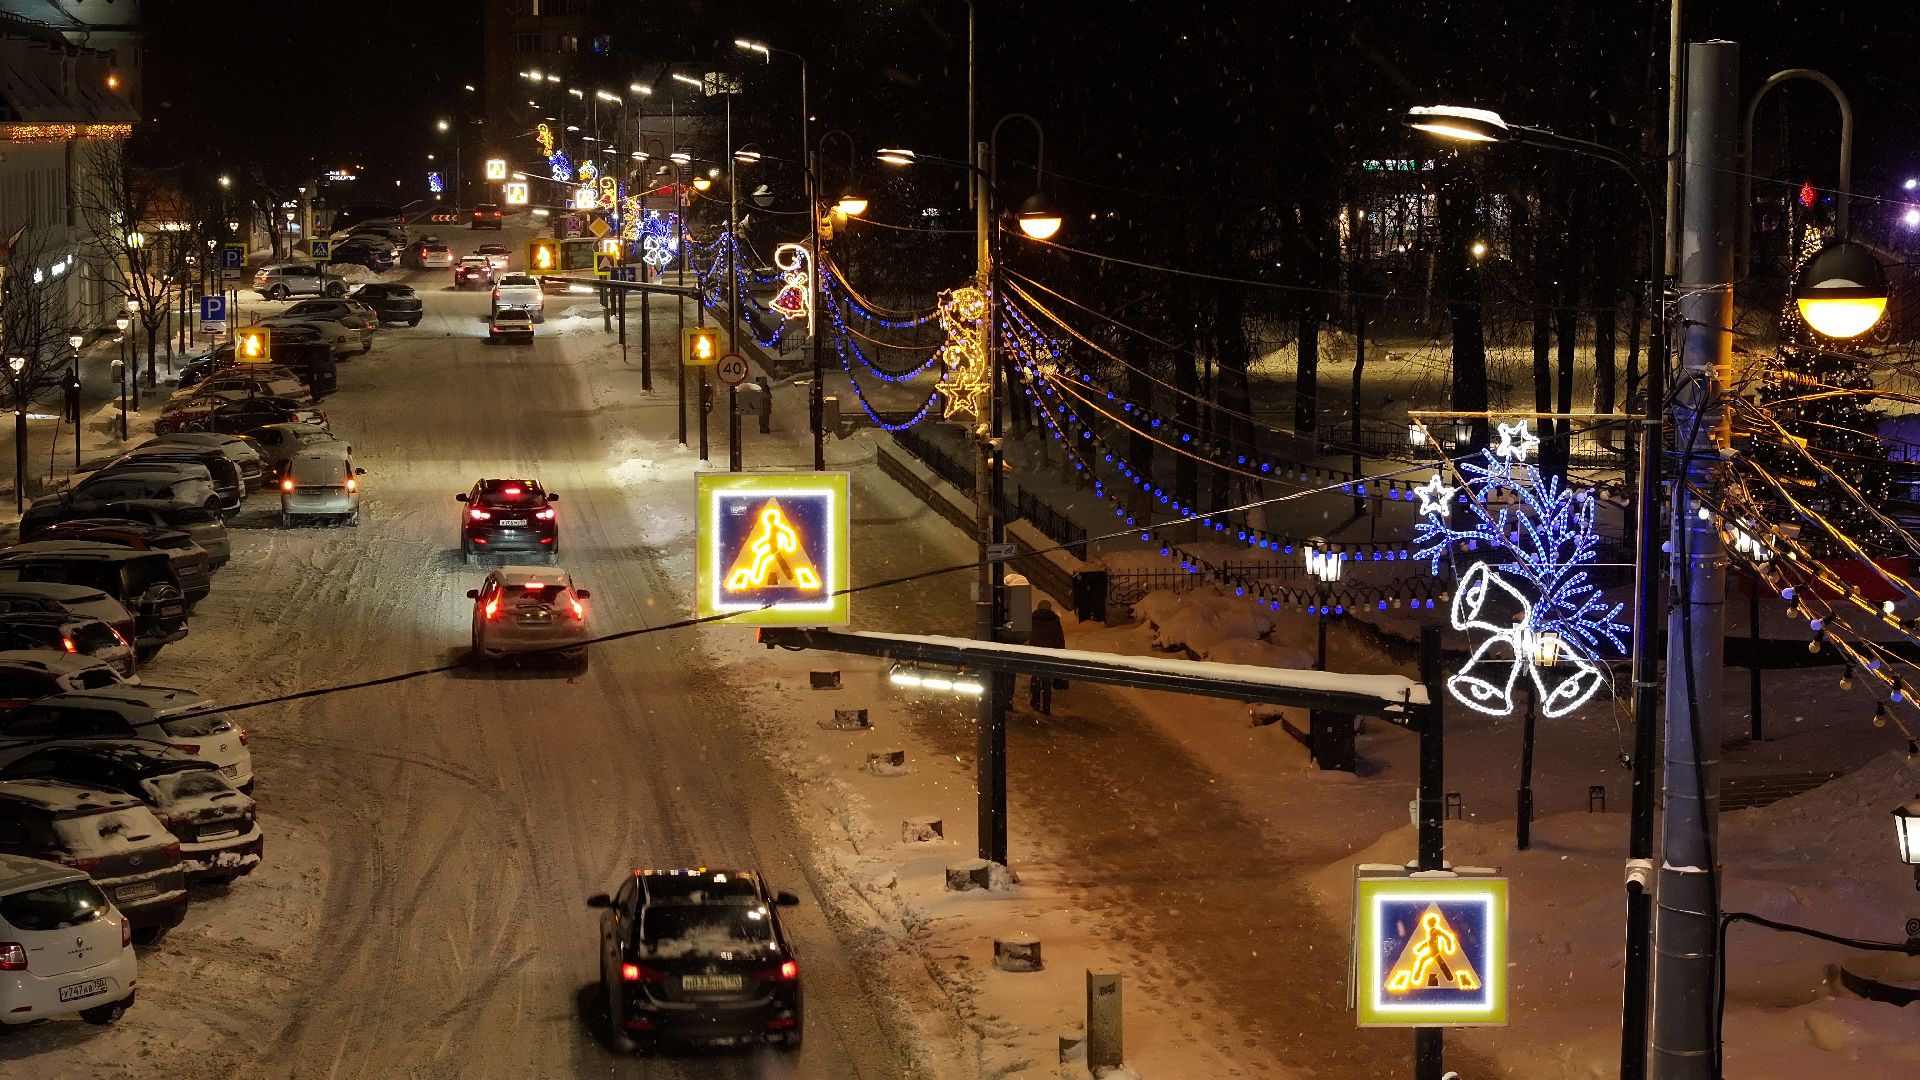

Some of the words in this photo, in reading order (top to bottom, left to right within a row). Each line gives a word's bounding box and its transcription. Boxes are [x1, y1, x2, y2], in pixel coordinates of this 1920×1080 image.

[227, 252, 237, 266] P
[207, 299, 221, 318] P
[722, 362, 741, 374] 40
